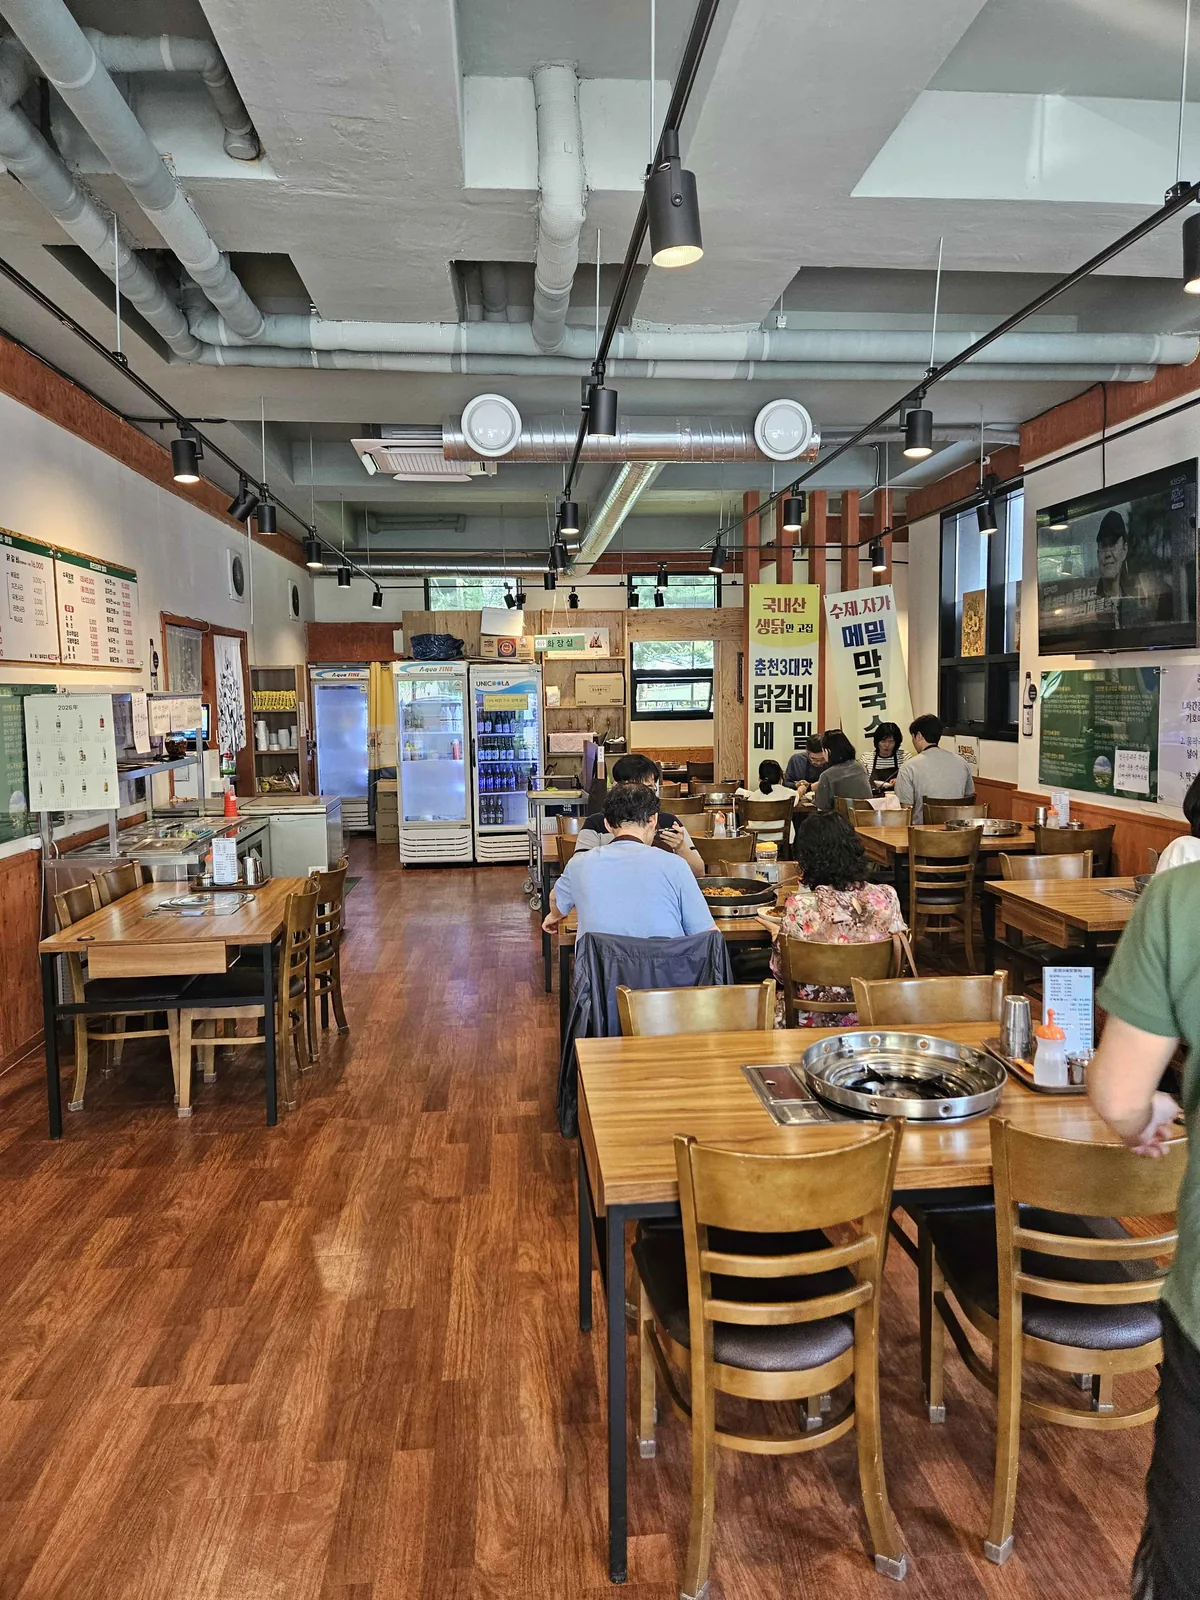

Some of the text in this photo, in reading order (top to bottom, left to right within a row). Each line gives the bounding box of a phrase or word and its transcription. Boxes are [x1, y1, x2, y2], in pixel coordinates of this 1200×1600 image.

[762, 597, 806, 614] 국내산
[797, 623, 814, 634] 고집
[841, 620, 887, 648] 메밀
[547, 639, 574, 648] 화장실
[754, 658, 813, 676] 춘천3대맛
[754, 684, 812, 713] 닭갈비
